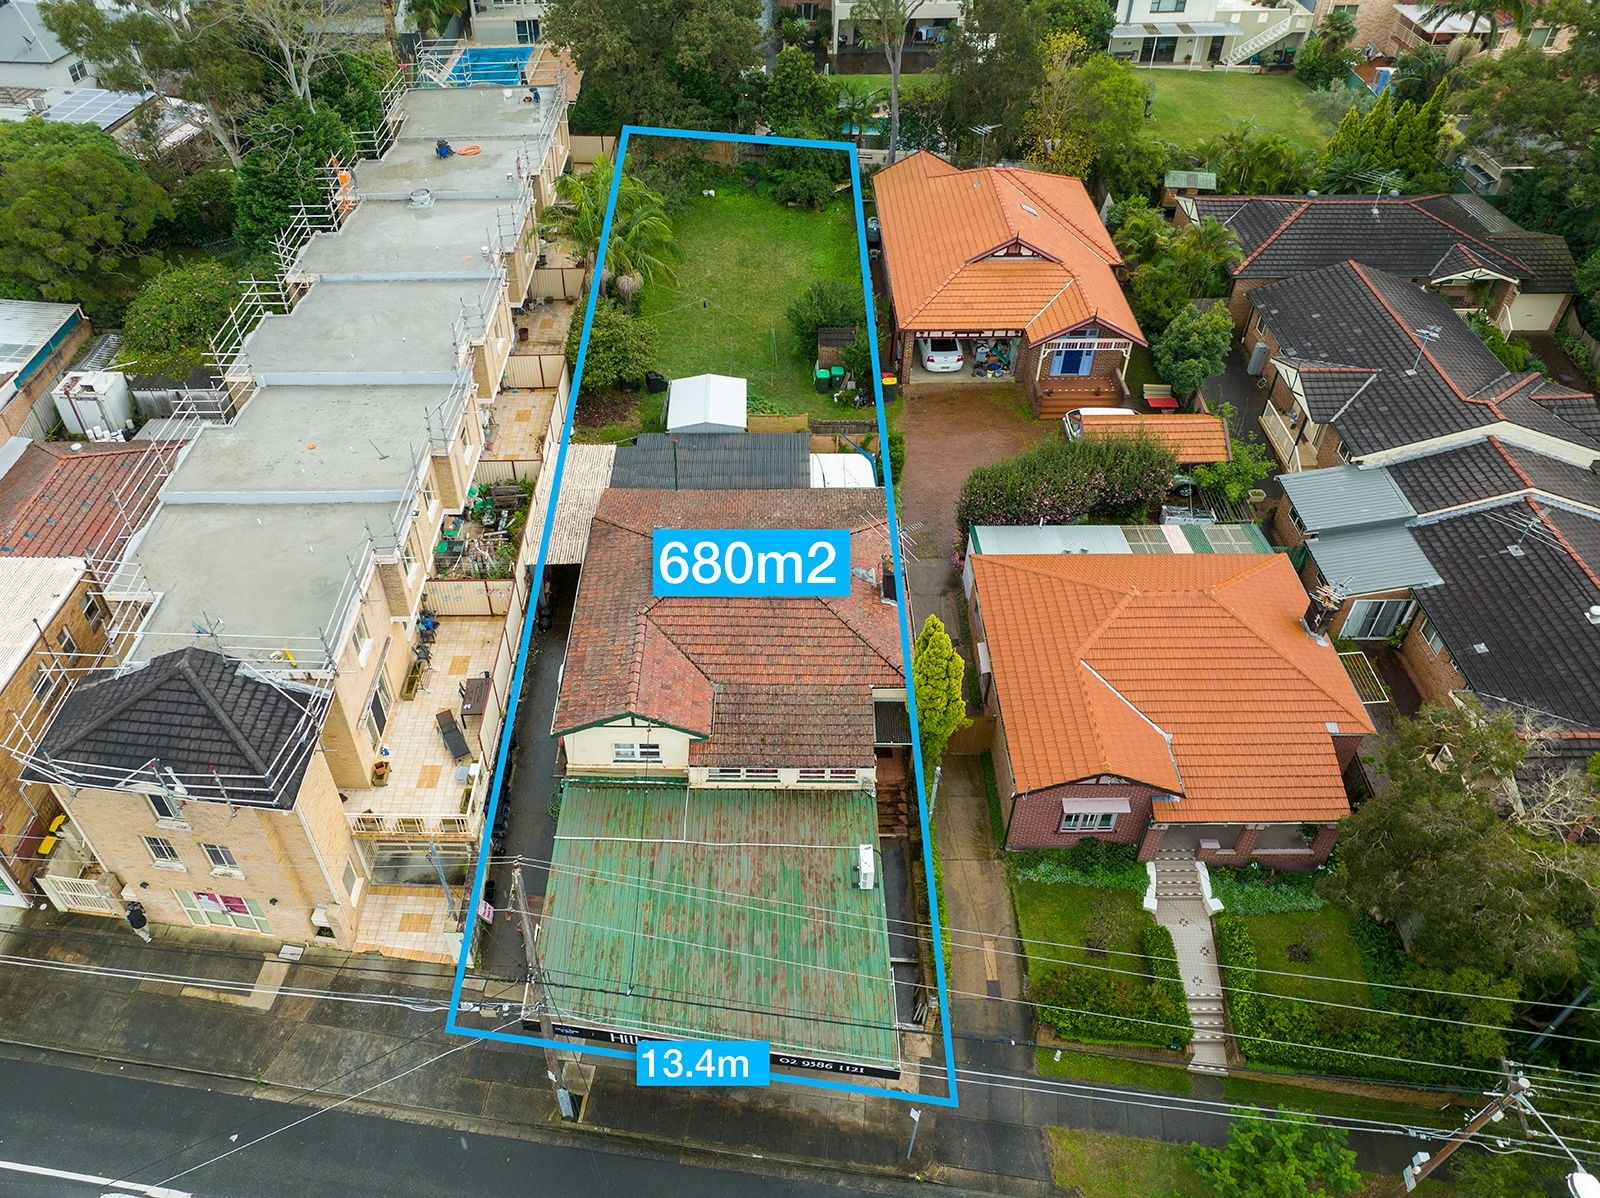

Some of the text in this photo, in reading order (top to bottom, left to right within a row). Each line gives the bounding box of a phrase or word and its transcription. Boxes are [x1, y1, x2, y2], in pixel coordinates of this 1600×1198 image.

[610, 1033, 649, 1045] Hill
[801, 1060, 833, 1070] 9586
[839, 1064, 865, 1074] 1121
